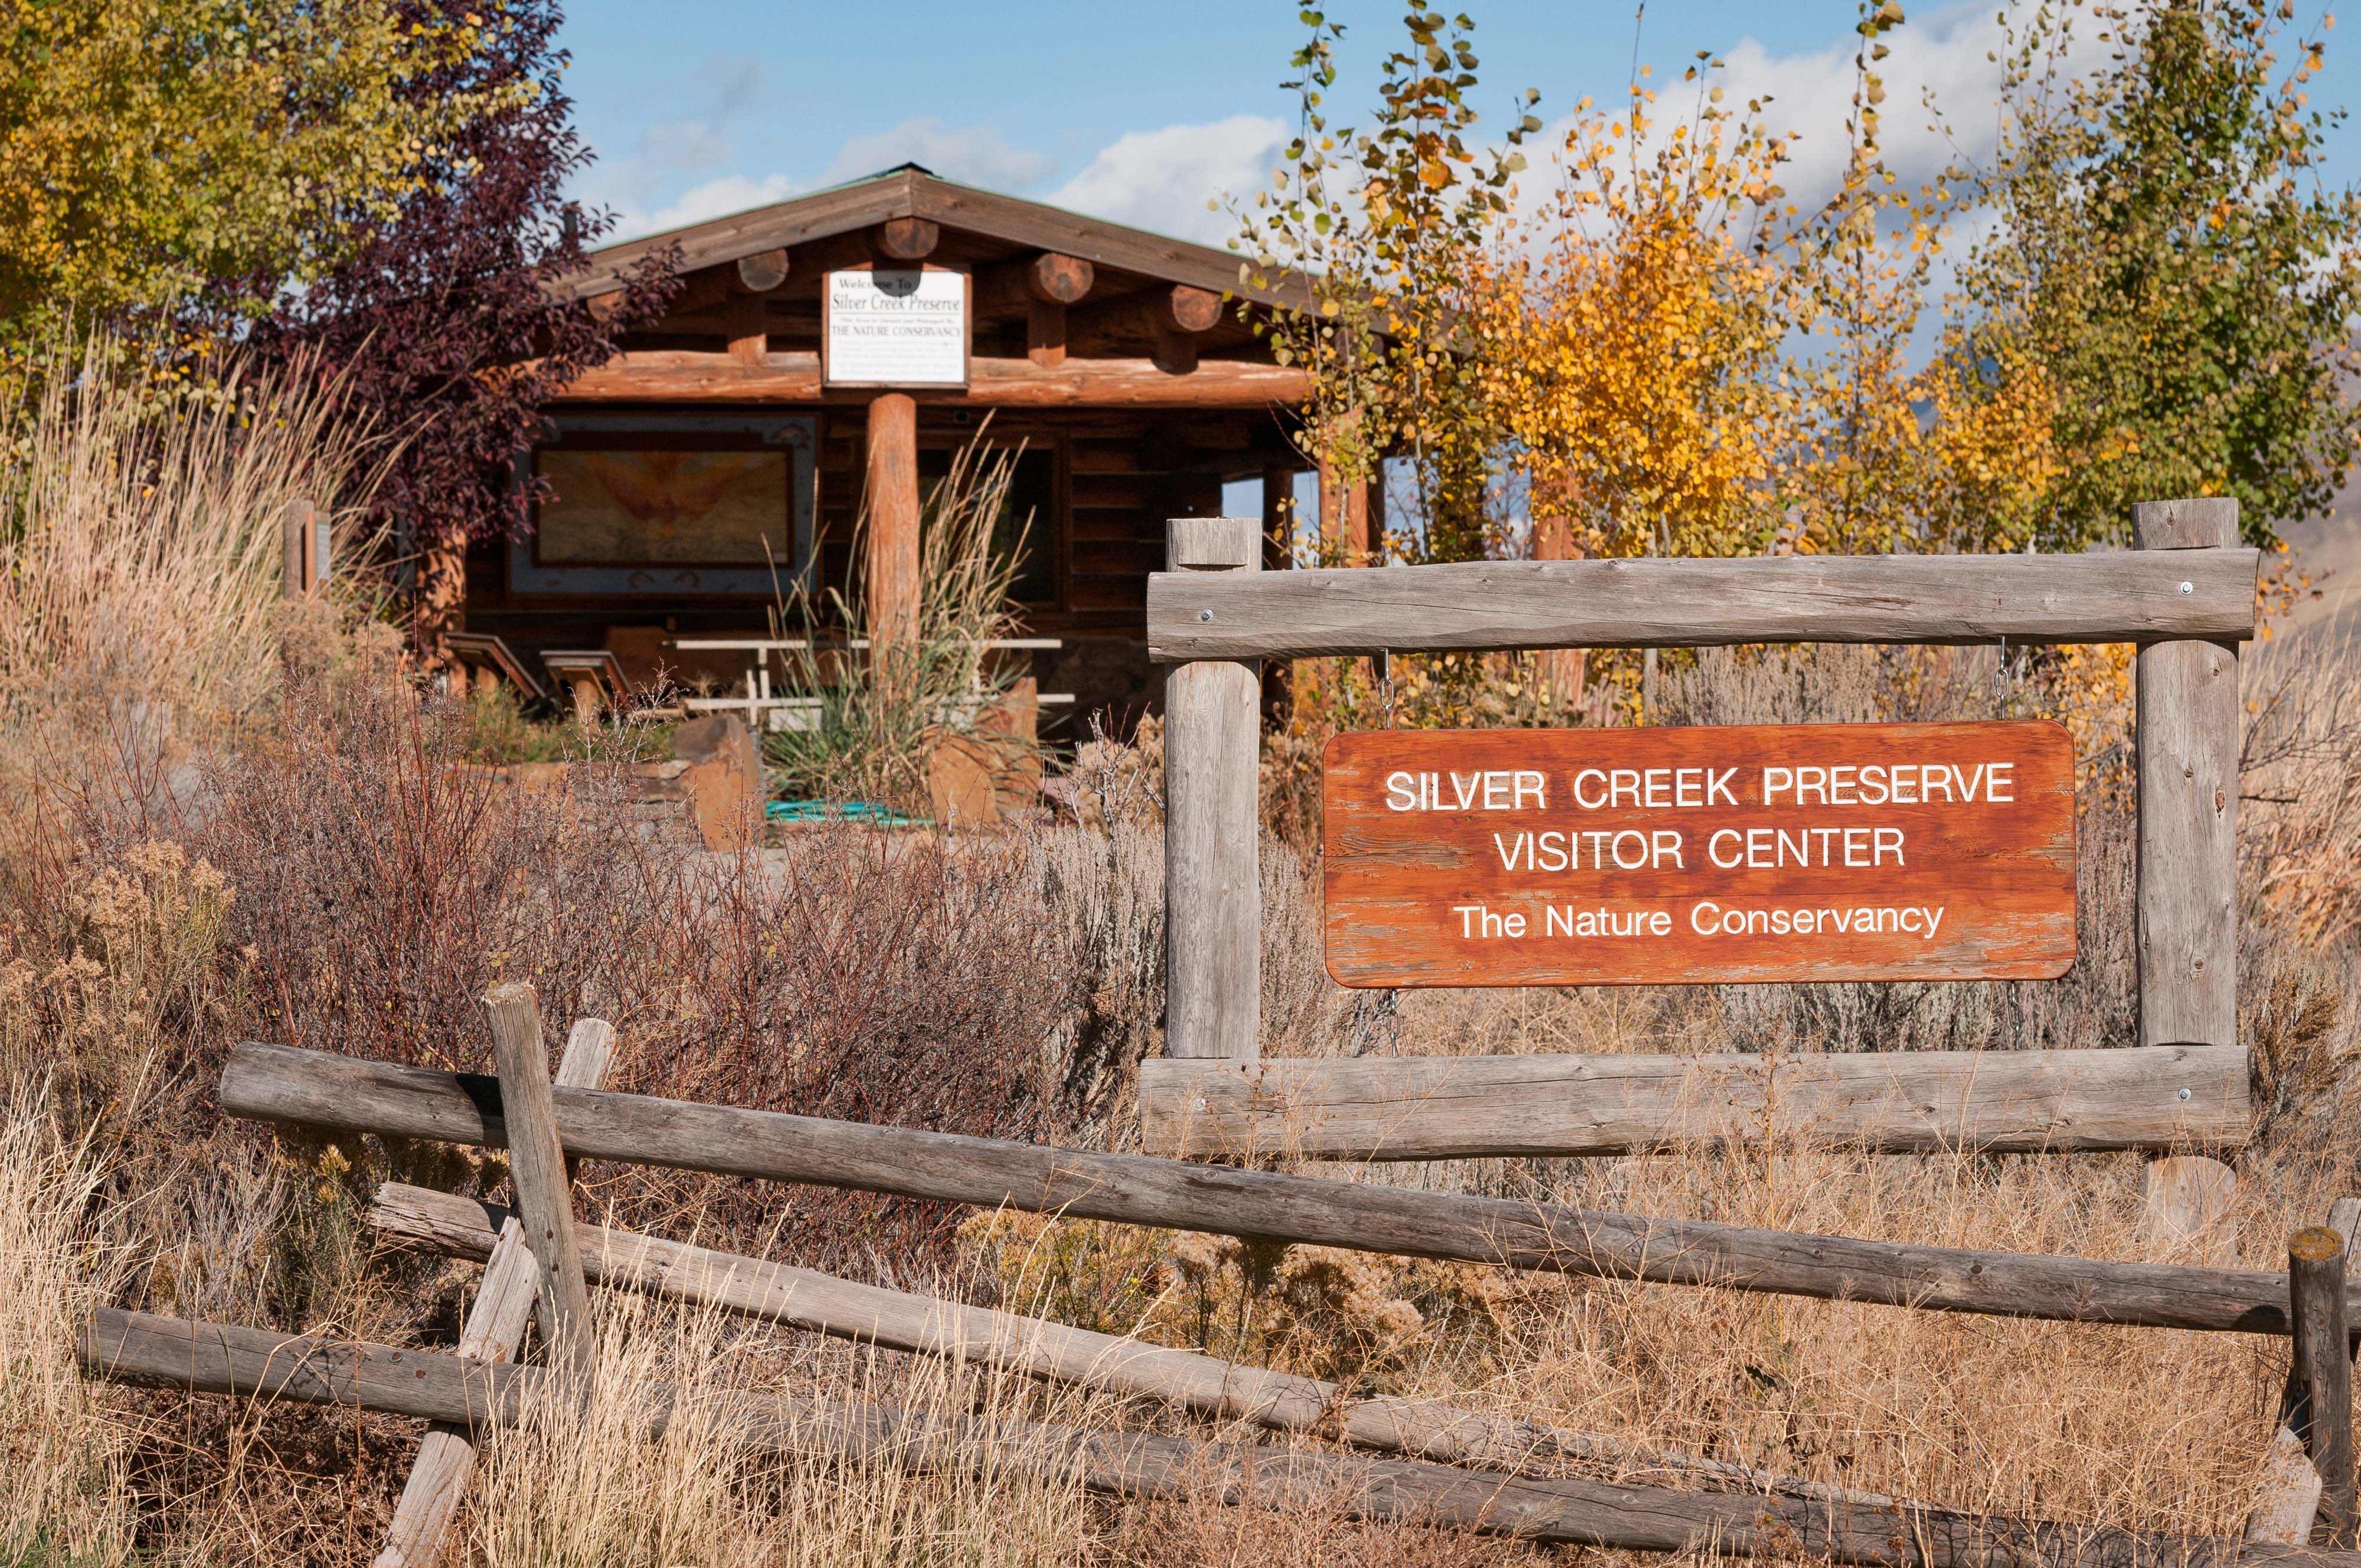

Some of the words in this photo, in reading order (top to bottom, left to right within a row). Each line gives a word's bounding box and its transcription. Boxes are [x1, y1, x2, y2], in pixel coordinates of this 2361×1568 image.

[839, 278, 892, 290] Welcome
[898, 278, 913, 290] To
[832, 293, 866, 311] Silver
[871, 293, 905, 311] Creek
[909, 294, 960, 312] Preserve
[832, 325, 850, 336] THE
[854, 325, 889, 336] NATURE
[892, 326, 961, 338] CONSERVANCY
[1385, 770, 1546, 812] SILVER
[1573, 767, 1739, 809] CREEK
[1763, 762, 2014, 806] PRESERVE
[1493, 829, 1685, 872] VISITOR
[1708, 827, 1905, 869] CENTER
[1453, 905, 1527, 939] The
[1546, 904, 1672, 937] Nature
[1690, 901, 1945, 940] Conservancy
